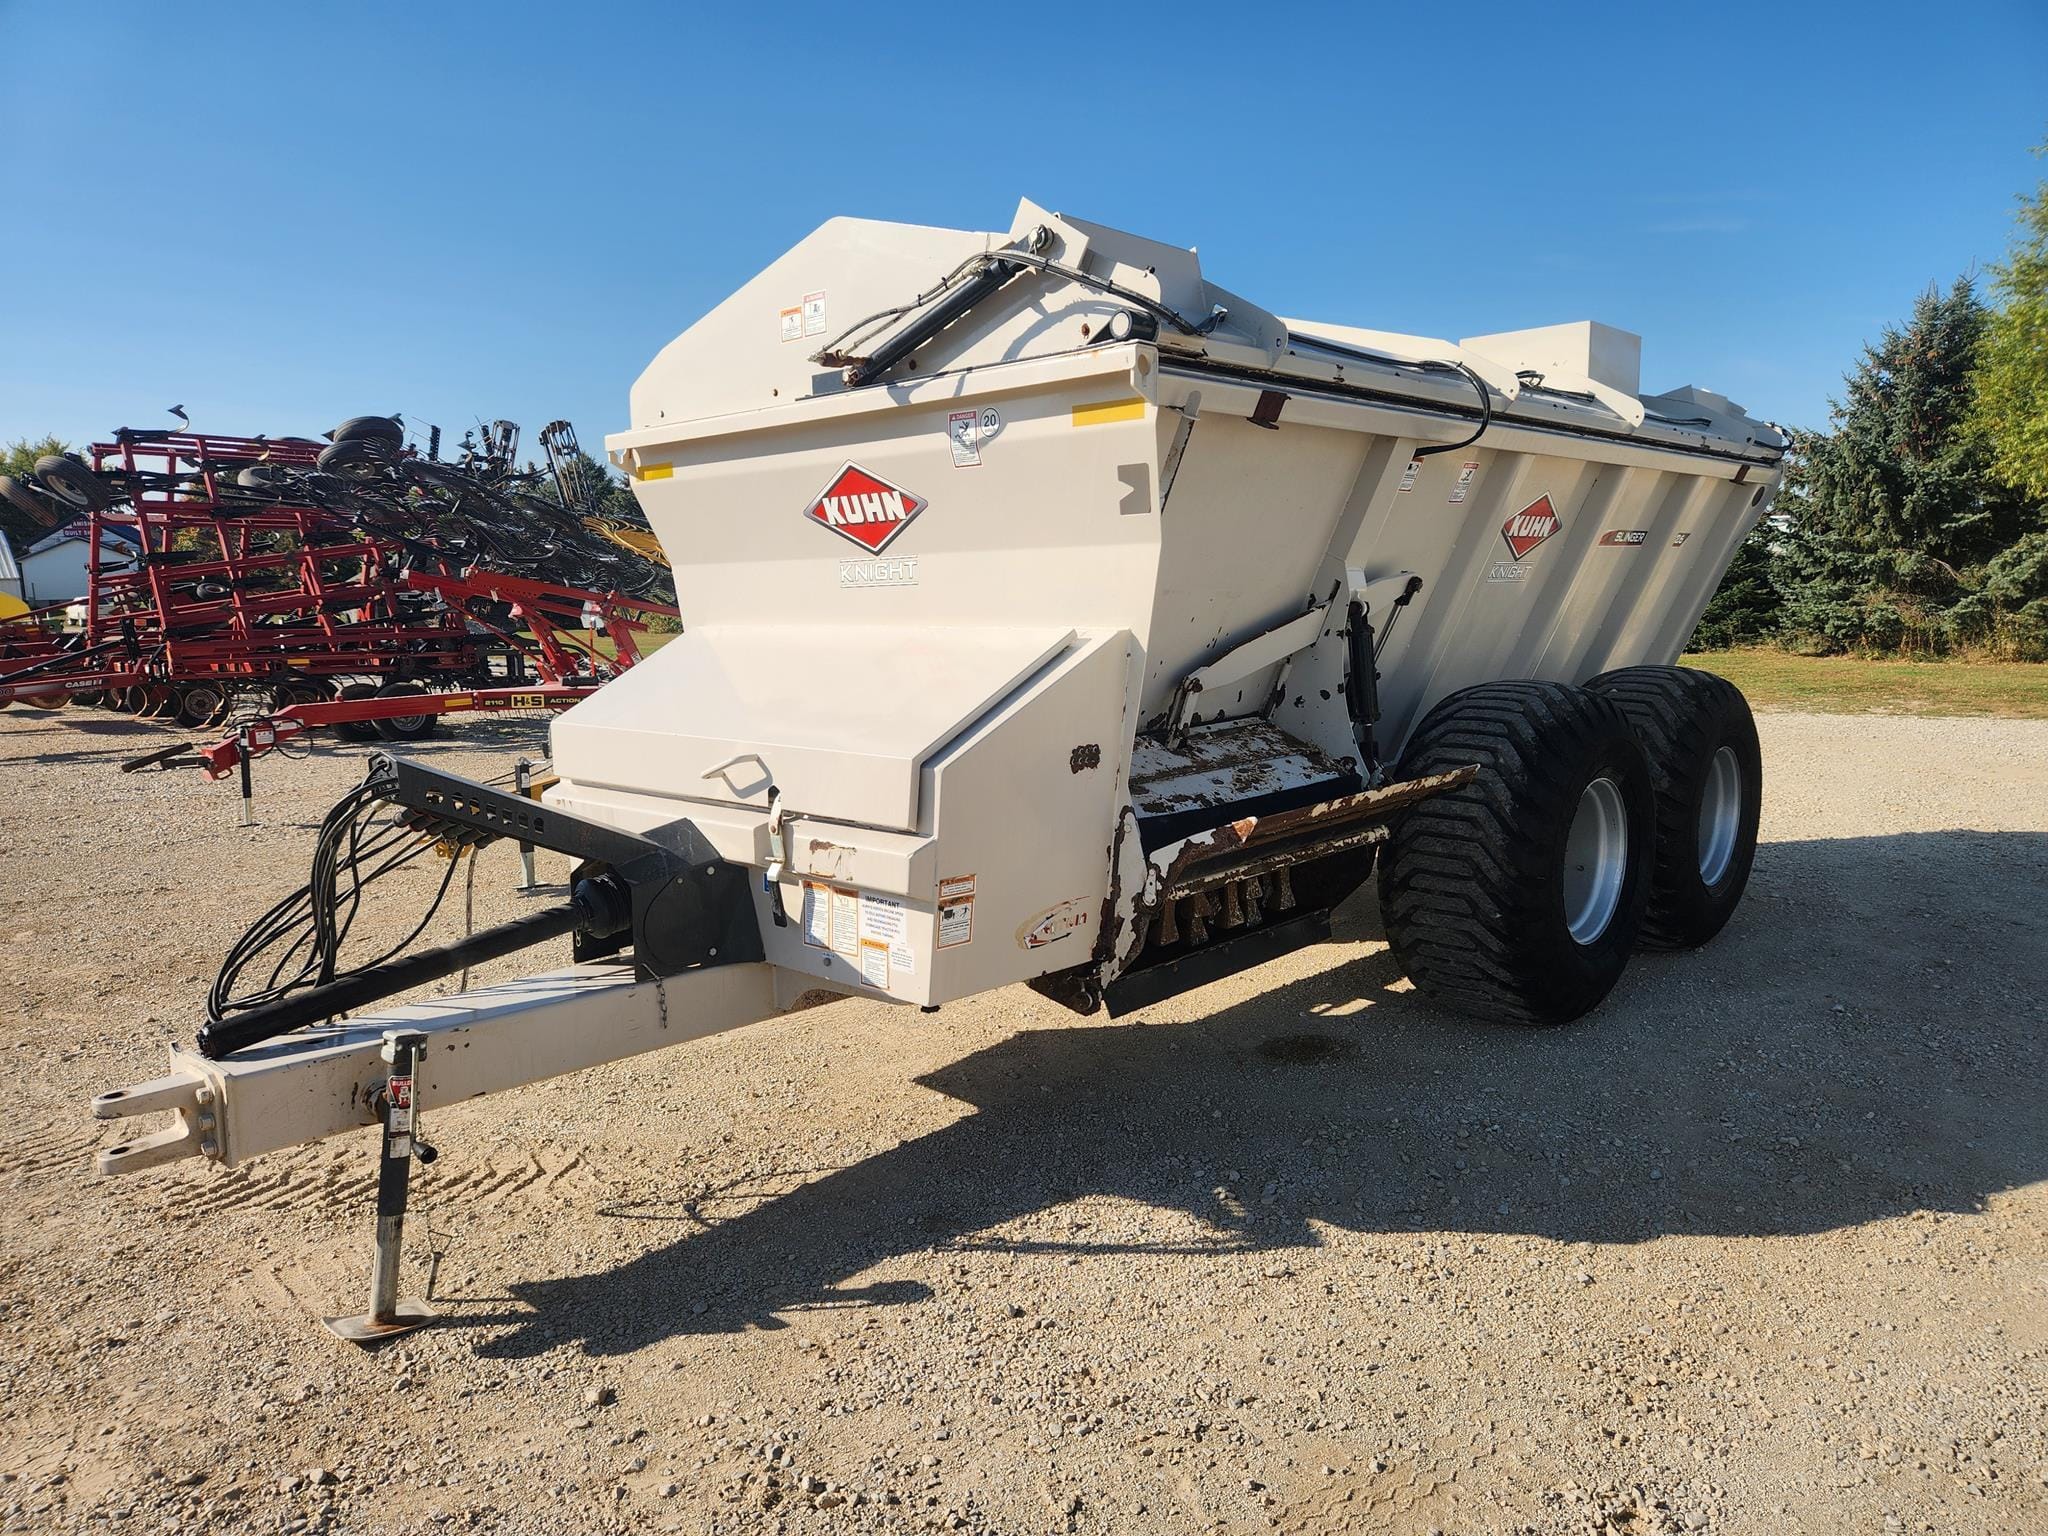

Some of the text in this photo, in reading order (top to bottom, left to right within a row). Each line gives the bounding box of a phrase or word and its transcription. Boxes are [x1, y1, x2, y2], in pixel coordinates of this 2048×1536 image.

[983, 414, 996, 427] 20
[822, 490, 907, 525] KUHN
[1508, 515, 1556, 537] KUHN
[1614, 532, 1645, 543] SLINGER
[839, 561, 918, 582] KNIGHT
[1488, 565, 1533, 579] KNIGHT
[513, 695, 543, 707] H&S
[865, 895, 901, 908] IMPORTANT
